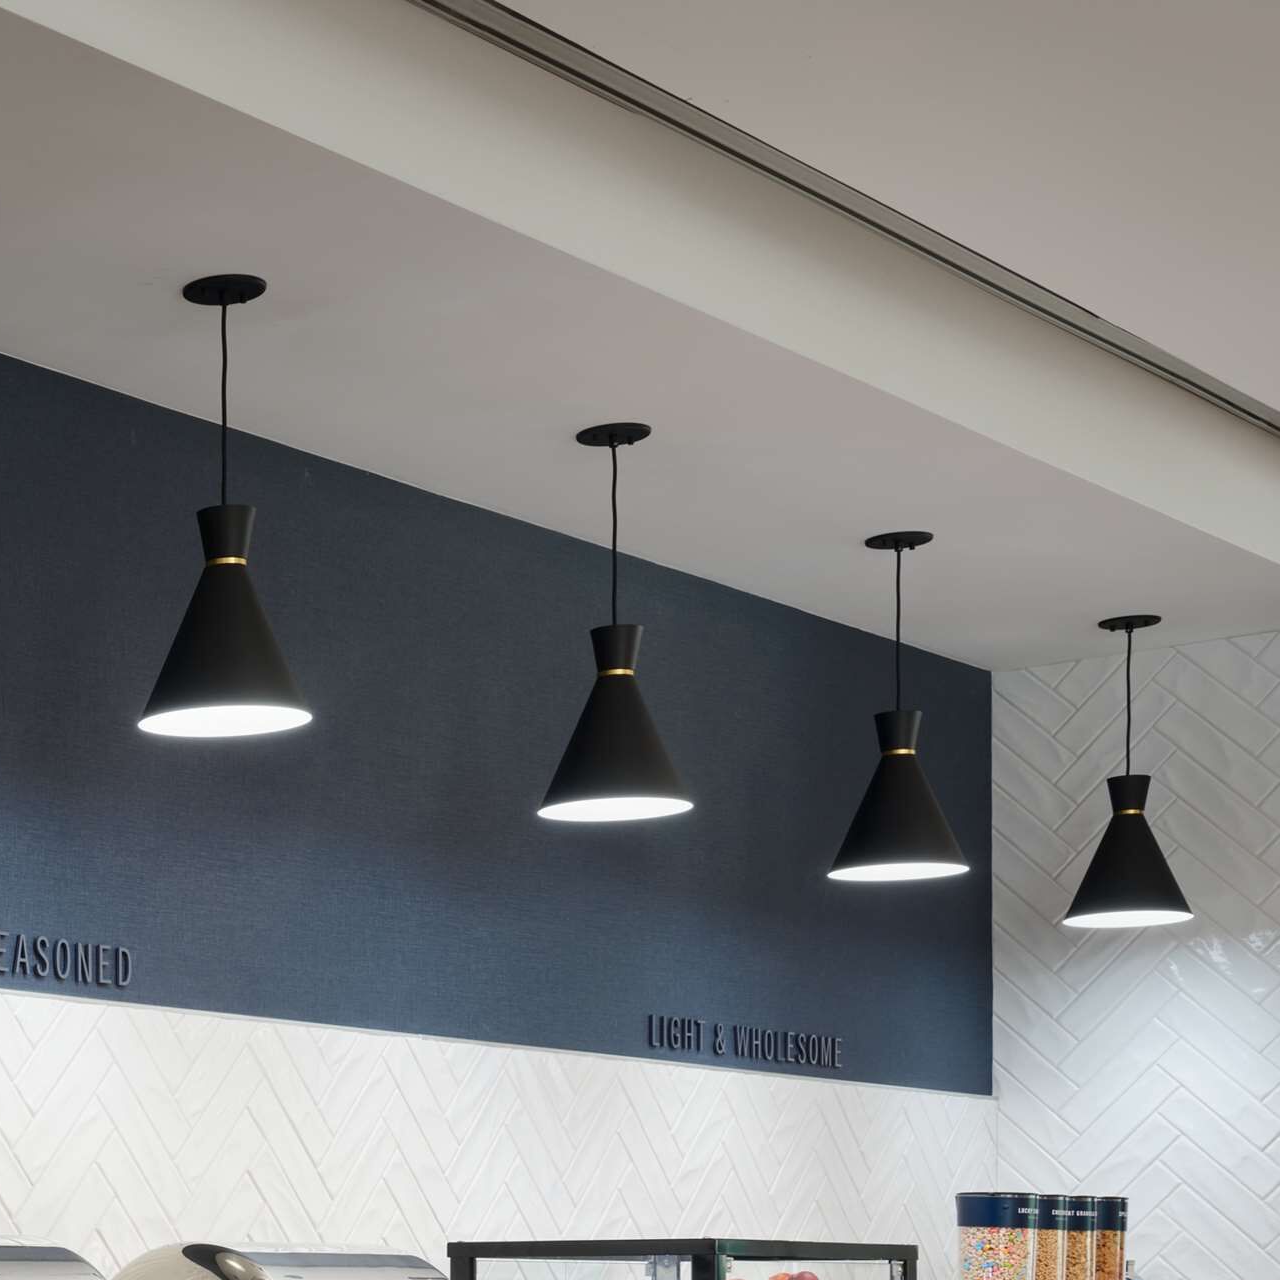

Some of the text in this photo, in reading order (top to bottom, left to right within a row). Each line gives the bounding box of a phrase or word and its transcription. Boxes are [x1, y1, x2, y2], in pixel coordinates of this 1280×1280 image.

[648, 1013, 842, 1068] LIGHT & WHOLESOME
